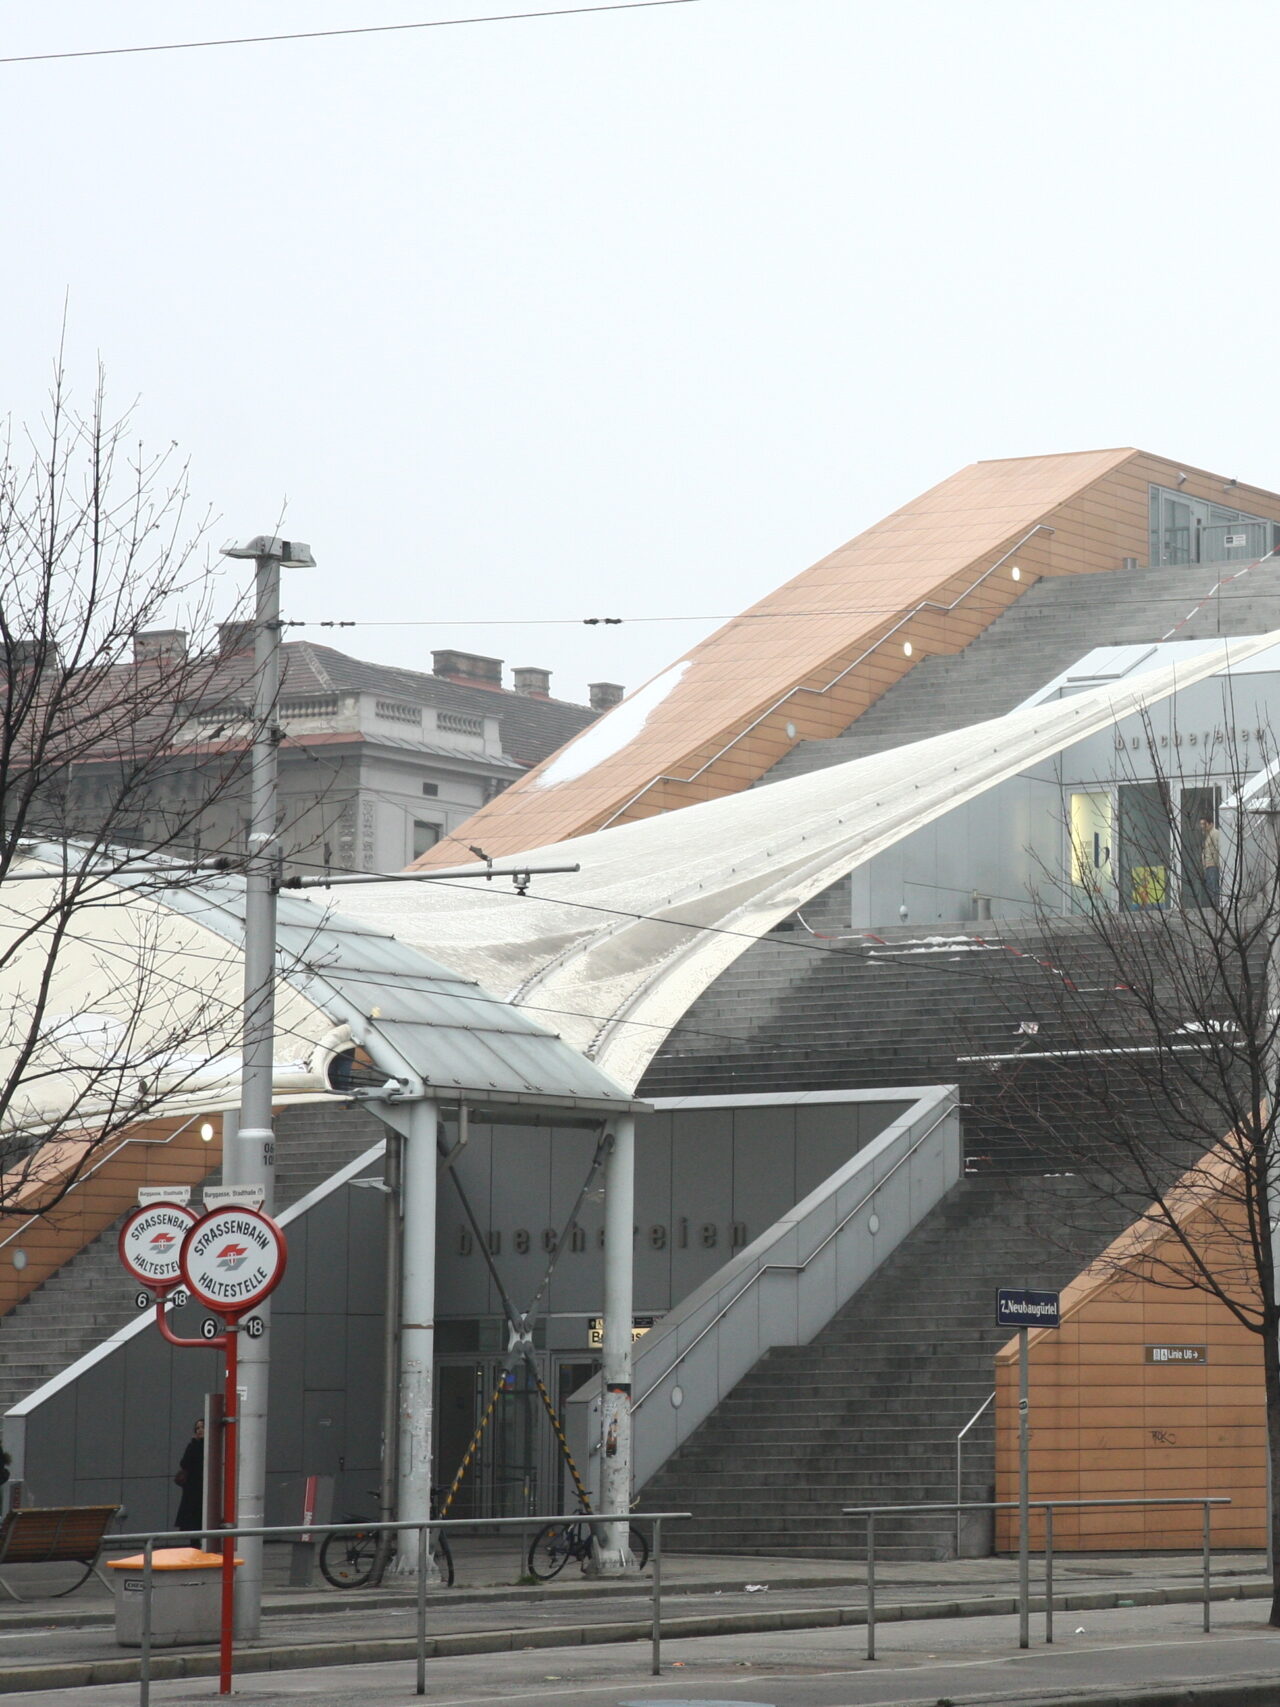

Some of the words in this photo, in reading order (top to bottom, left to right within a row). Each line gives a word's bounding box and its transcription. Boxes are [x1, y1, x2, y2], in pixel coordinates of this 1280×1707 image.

[232, 1188, 256, 1197] Stadthalle
[131, 1214, 191, 1241] STRASSENBAH
[459, 1216, 747, 1256] buecheien
[194, 1220, 270, 1256] STRASSENBAHN
[198, 1266, 268, 1298] HALTESTELLE
[137, 1295, 147, 1308] 6
[174, 1293, 187, 1306] 18
[1008, 1300, 1057, 1318] Neubaugürtel
[204, 1320, 216, 1340] 6
[248, 1320, 263, 1335] 18
[1168, 1349, 1182, 1359] Linie
[1184, 1350, 1192, 1359] U6
